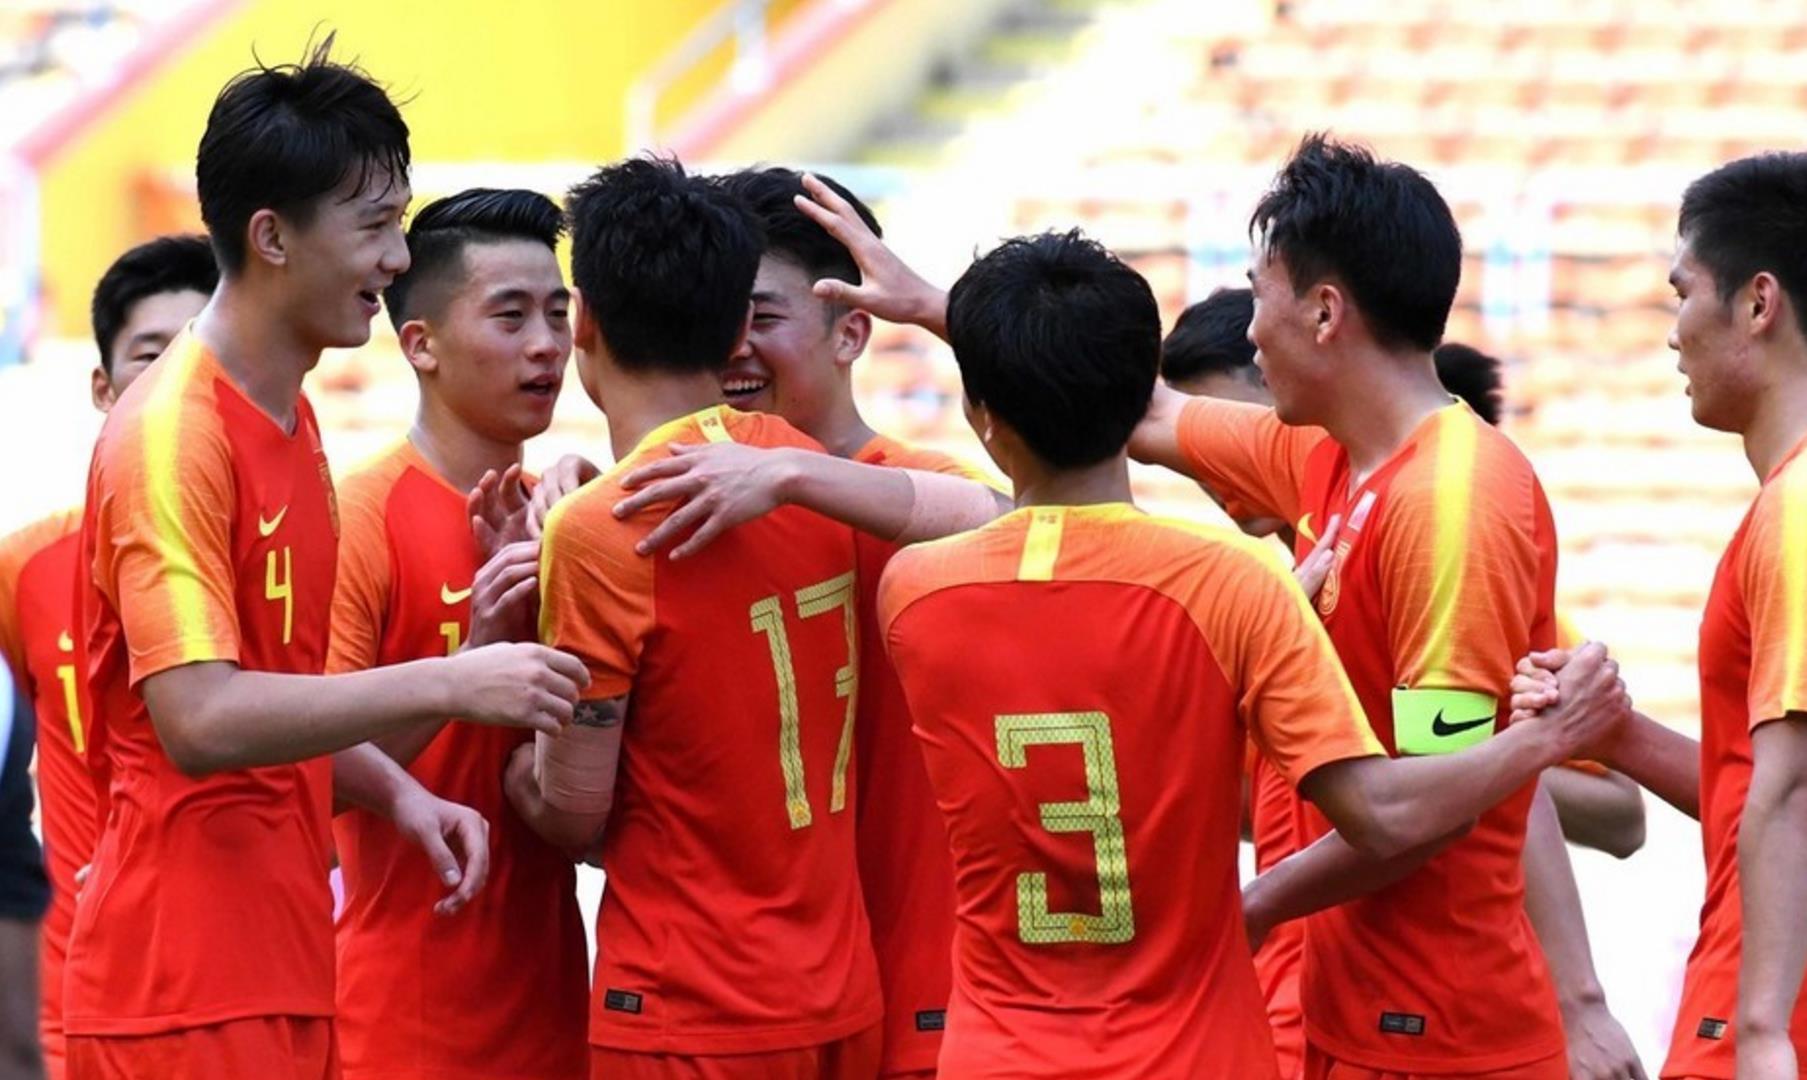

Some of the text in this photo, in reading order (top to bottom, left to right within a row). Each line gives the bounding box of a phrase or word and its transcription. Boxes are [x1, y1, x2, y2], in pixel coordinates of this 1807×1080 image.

[265, 545, 293, 645] 4
[750, 570, 858, 830] 17
[995, 711, 1136, 944] 3
